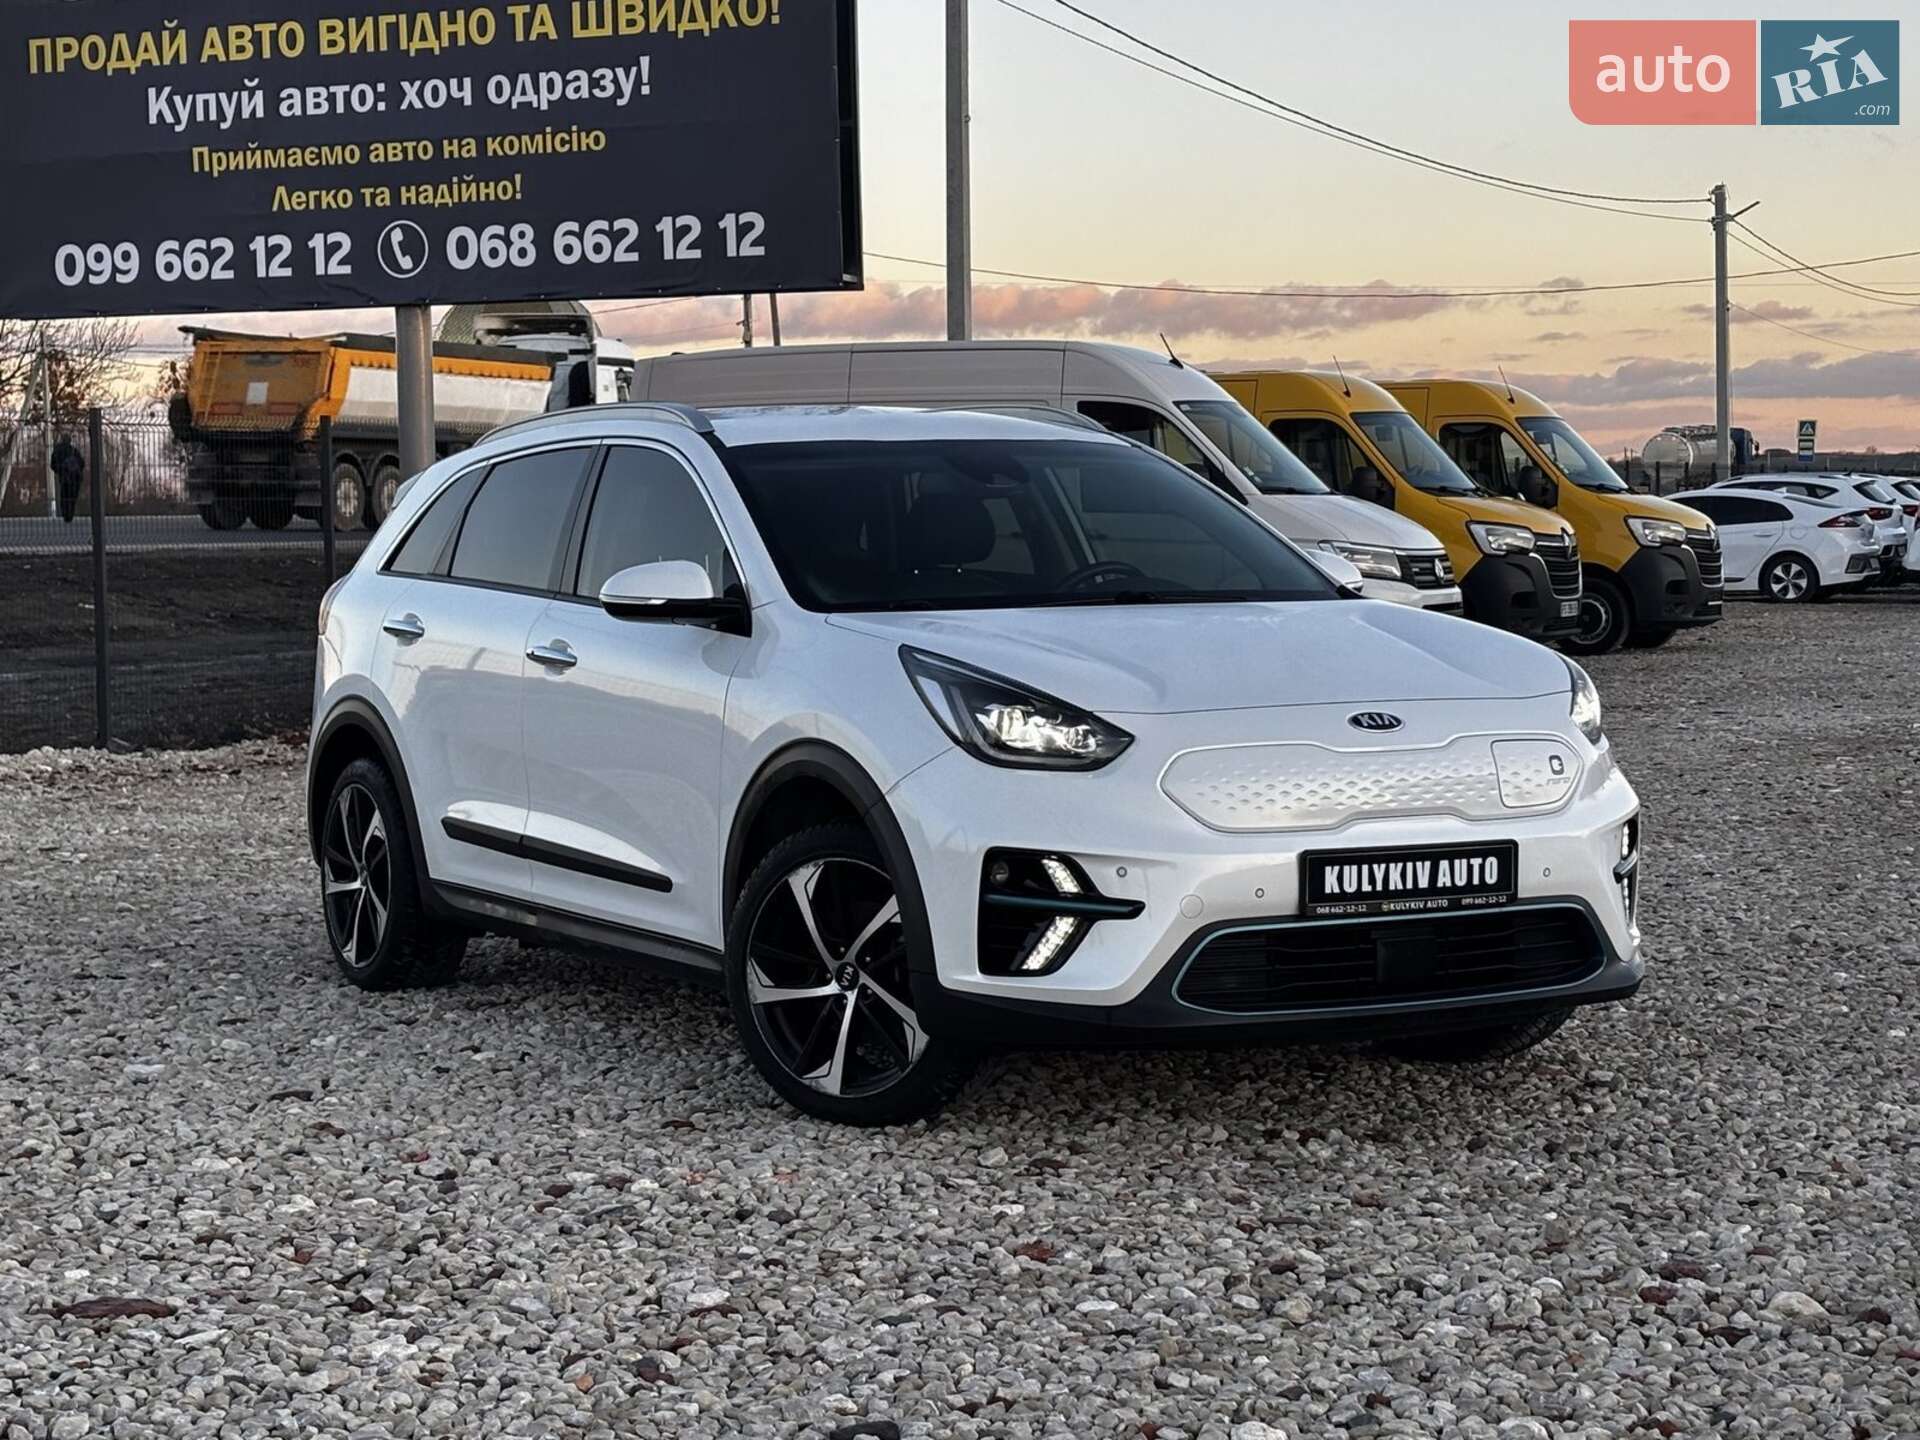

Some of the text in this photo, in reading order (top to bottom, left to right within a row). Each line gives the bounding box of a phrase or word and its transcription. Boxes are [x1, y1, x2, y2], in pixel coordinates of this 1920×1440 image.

[28, 0, 782, 75] ПРОДАЙ АВТО ВИГІДНО ТА ШВИДКО!
[147, 55, 651, 132] Купуй авто: хоч одразу!
[192, 125, 606, 178] Приймаємо авто на комісію
[272, 173, 522, 212] Легко та надійно!
[55, 231, 352, 286] 099 662 12 12
[446, 211, 765, 270] 068 662 12 12
[1358, 713, 1398, 727] KIA
[1324, 856, 1499, 894] KULYKIV AUTO
[1426, 899, 1448, 908] AUTO
[840, 965, 854, 986] KIA
